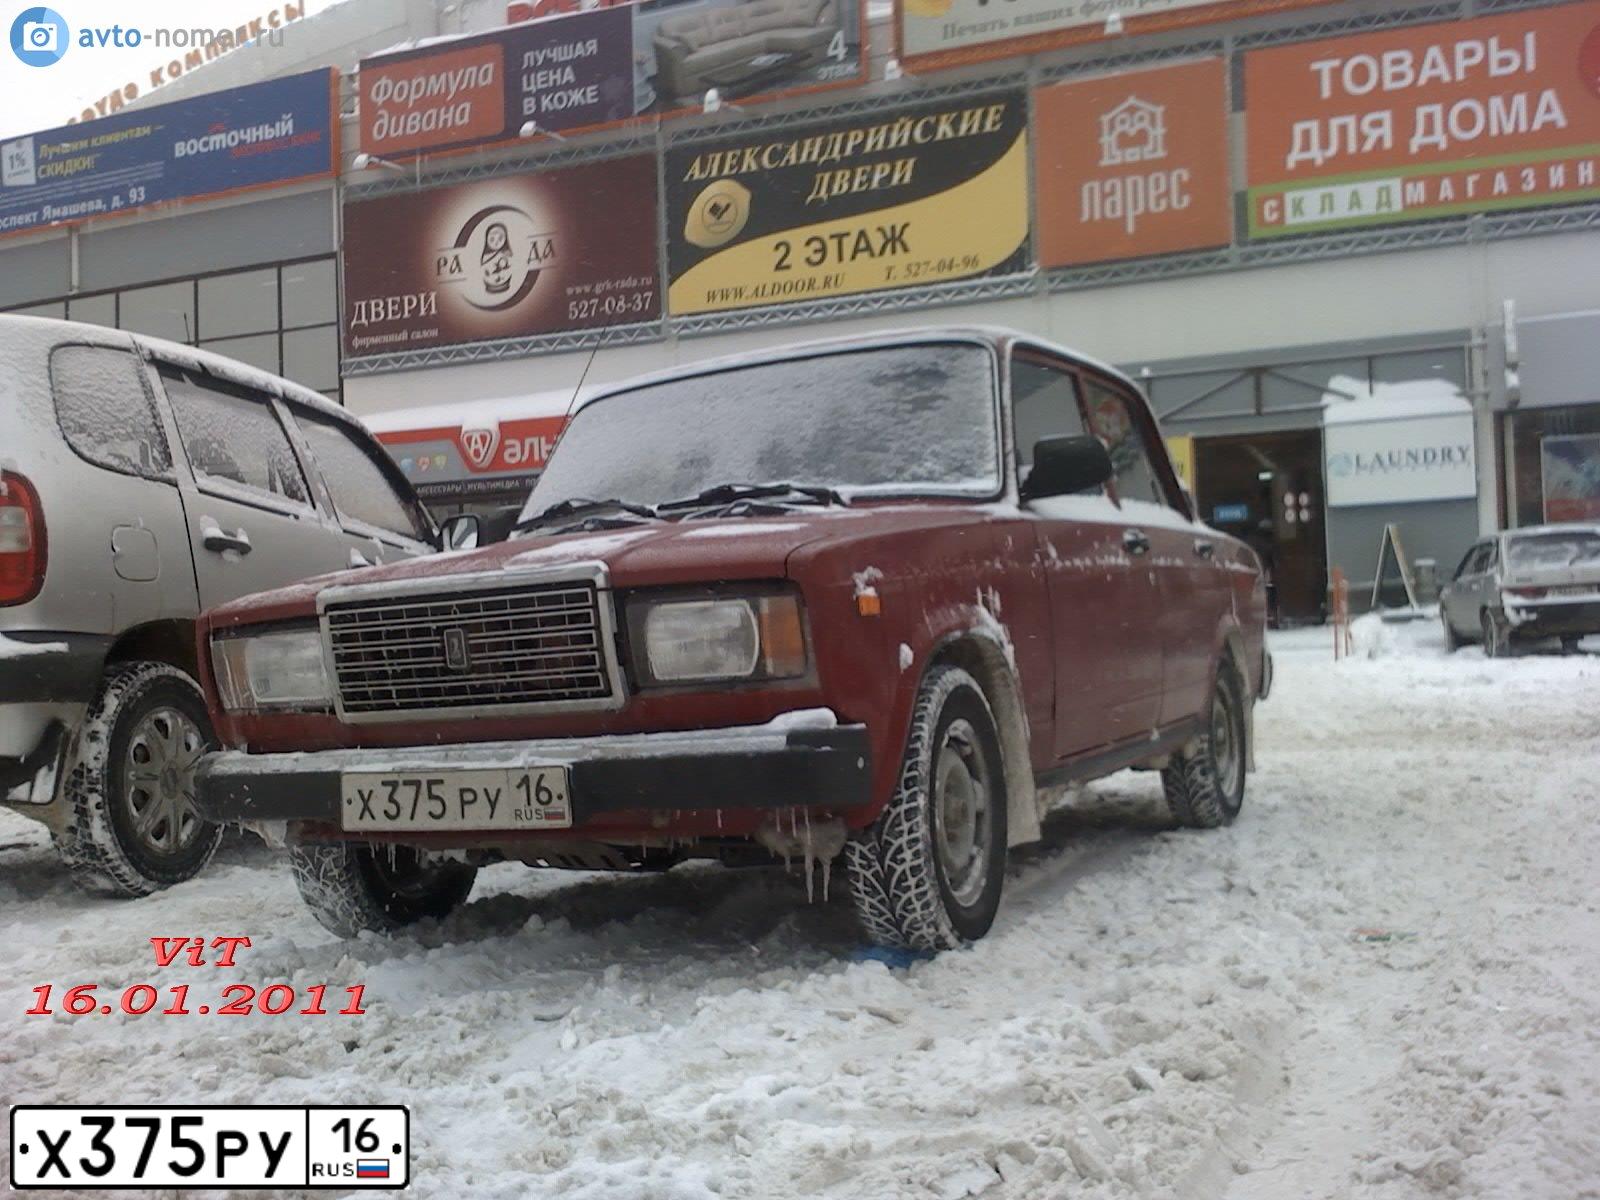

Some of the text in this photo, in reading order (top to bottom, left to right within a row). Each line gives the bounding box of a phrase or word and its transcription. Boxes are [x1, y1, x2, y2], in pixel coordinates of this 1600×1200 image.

[521, 39, 598, 70] ЛУЧШАЯ
[827, 30, 849, 61] 4
[521, 65, 576, 94] ЦЕНА
[1311, 31, 1536, 99] ТОВАРЫ
[370, 62, 495, 107] Формула
[522, 84, 600, 116] В КОЖЕ
[372, 102, 472, 141] дивана
[1286, 88, 1568, 170] ДЛЯ ДОМА
[683, 104, 1007, 183] АЛЕКСАНДРИЙСКИЕ
[128, 186, 146, 204] 93
[805, 157, 918, 205] ДВЕРИ
[773, 222, 911, 272] 2 ЭТАЖ
[904, 254, 981, 280] 527-04-96
[706, 273, 847, 304] WWW.ALDOOR.RU
[351, 291, 438, 330] ДВЕРИ
[568, 291, 653, 321] 527-08-37
[503, 433, 561, 464] аль
[1355, 445, 1471, 469] LAUNDRY
[516, 773, 553, 807] 16
[514, 806, 544, 822] RUS
